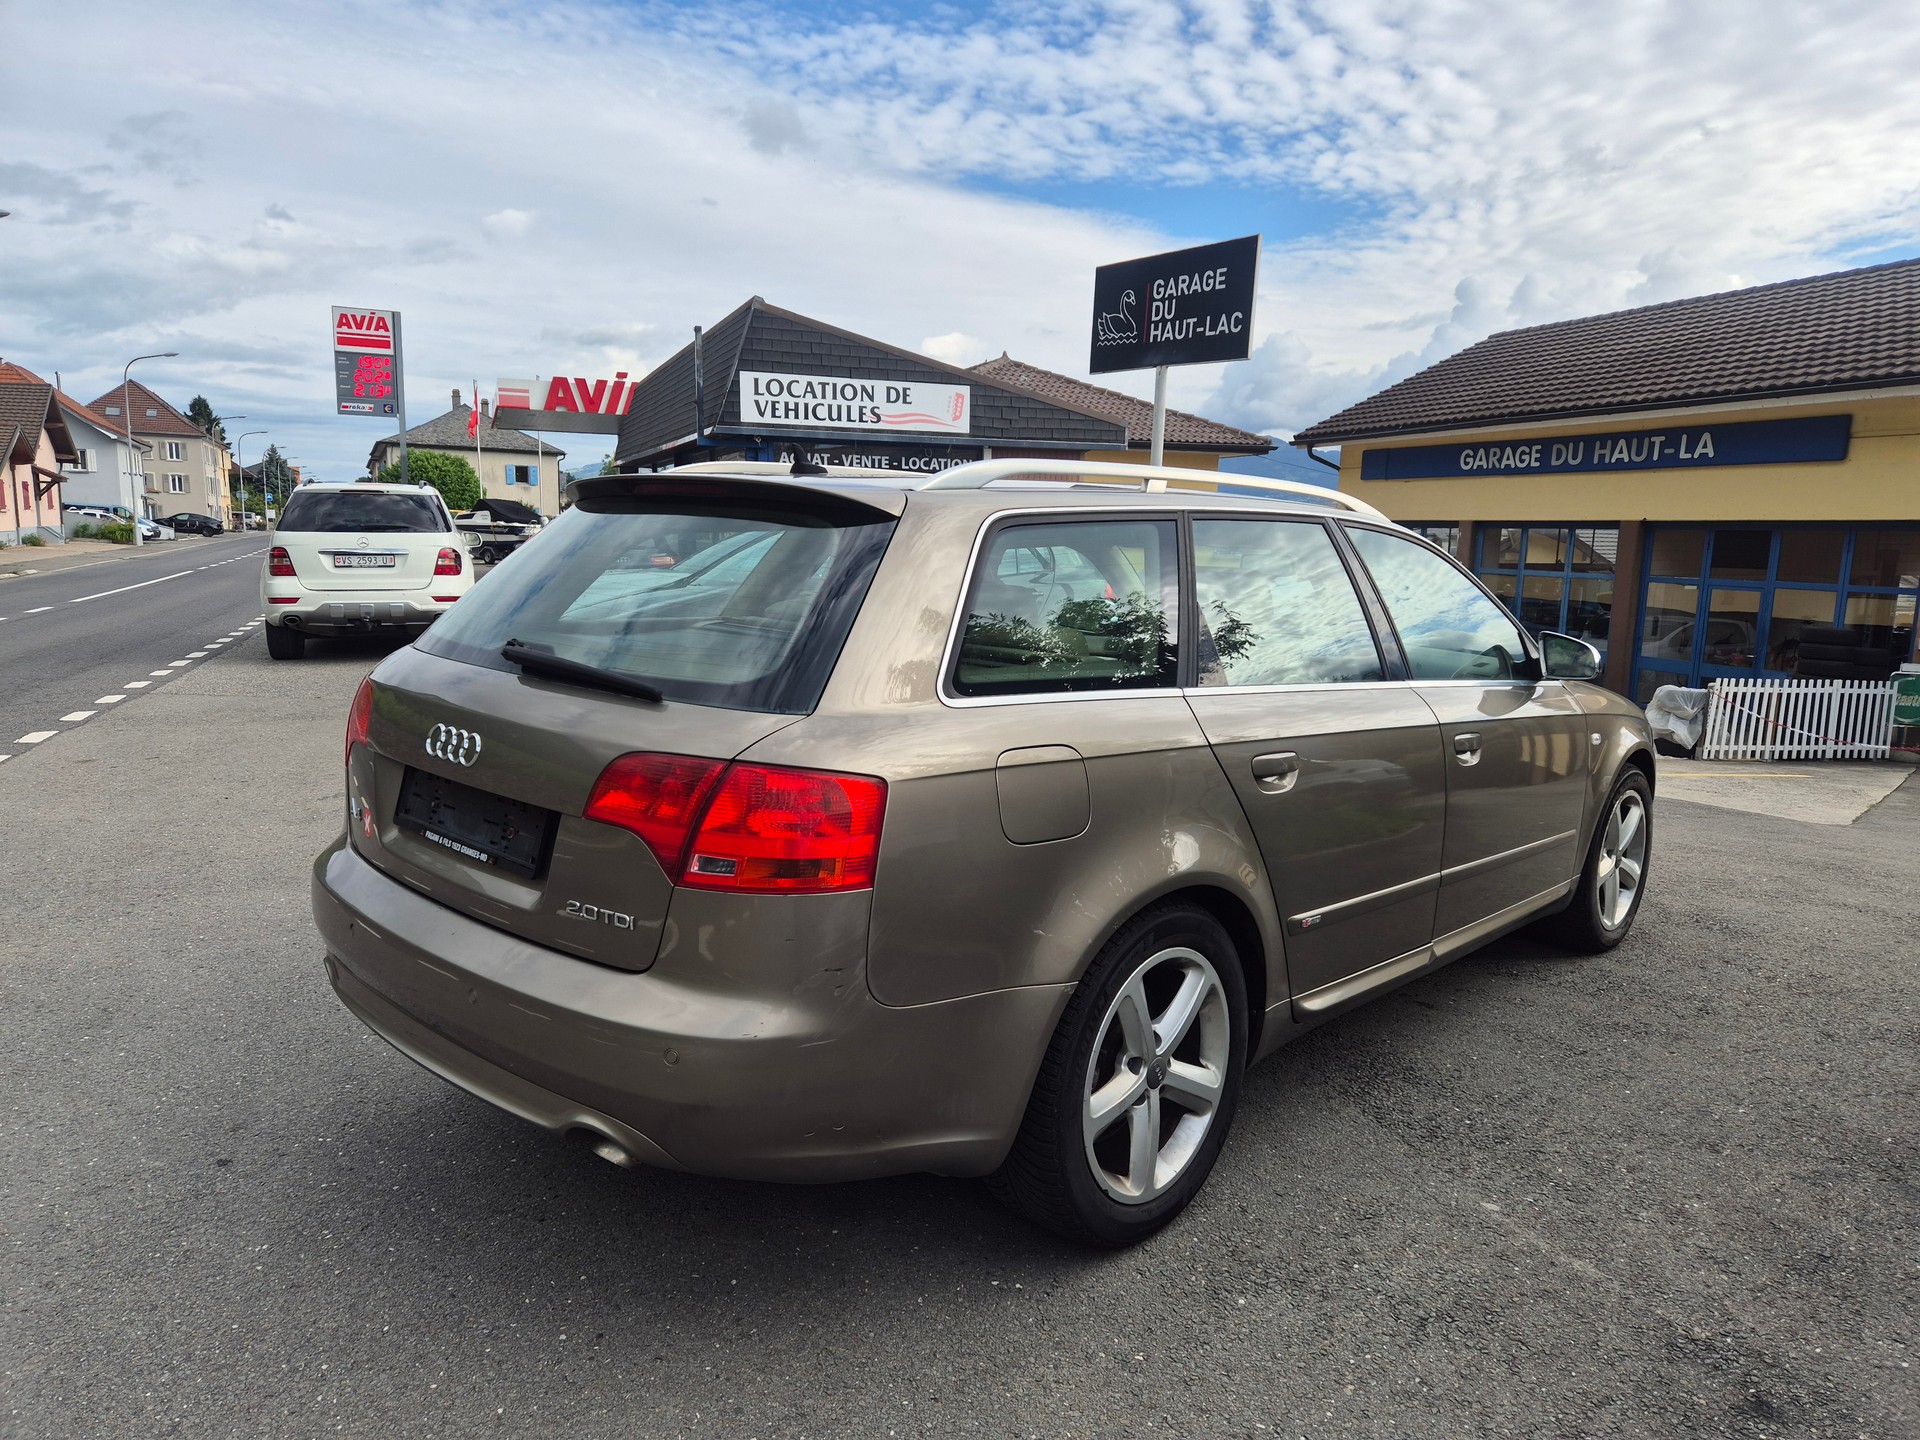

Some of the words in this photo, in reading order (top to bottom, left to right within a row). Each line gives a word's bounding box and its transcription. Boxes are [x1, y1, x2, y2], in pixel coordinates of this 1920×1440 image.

[1153, 267, 1228, 299] GARAGE
[1151, 298, 1176, 321] DU
[1150, 312, 1243, 343] HAUT-LAC
[753, 377, 875, 403] LOCATION
[885, 386, 913, 405] DE
[754, 399, 882, 424] VEHICULES
[841, 454, 890, 469] VENTE
[1460, 445, 1542, 471] GARAGE
[1550, 441, 1585, 466] DU
[1593, 432, 1716, 464] HAUT-LA
[356, 556, 378, 565] 2593
[565, 899, 598, 921] 2.0
[600, 908, 635, 931] TDI
